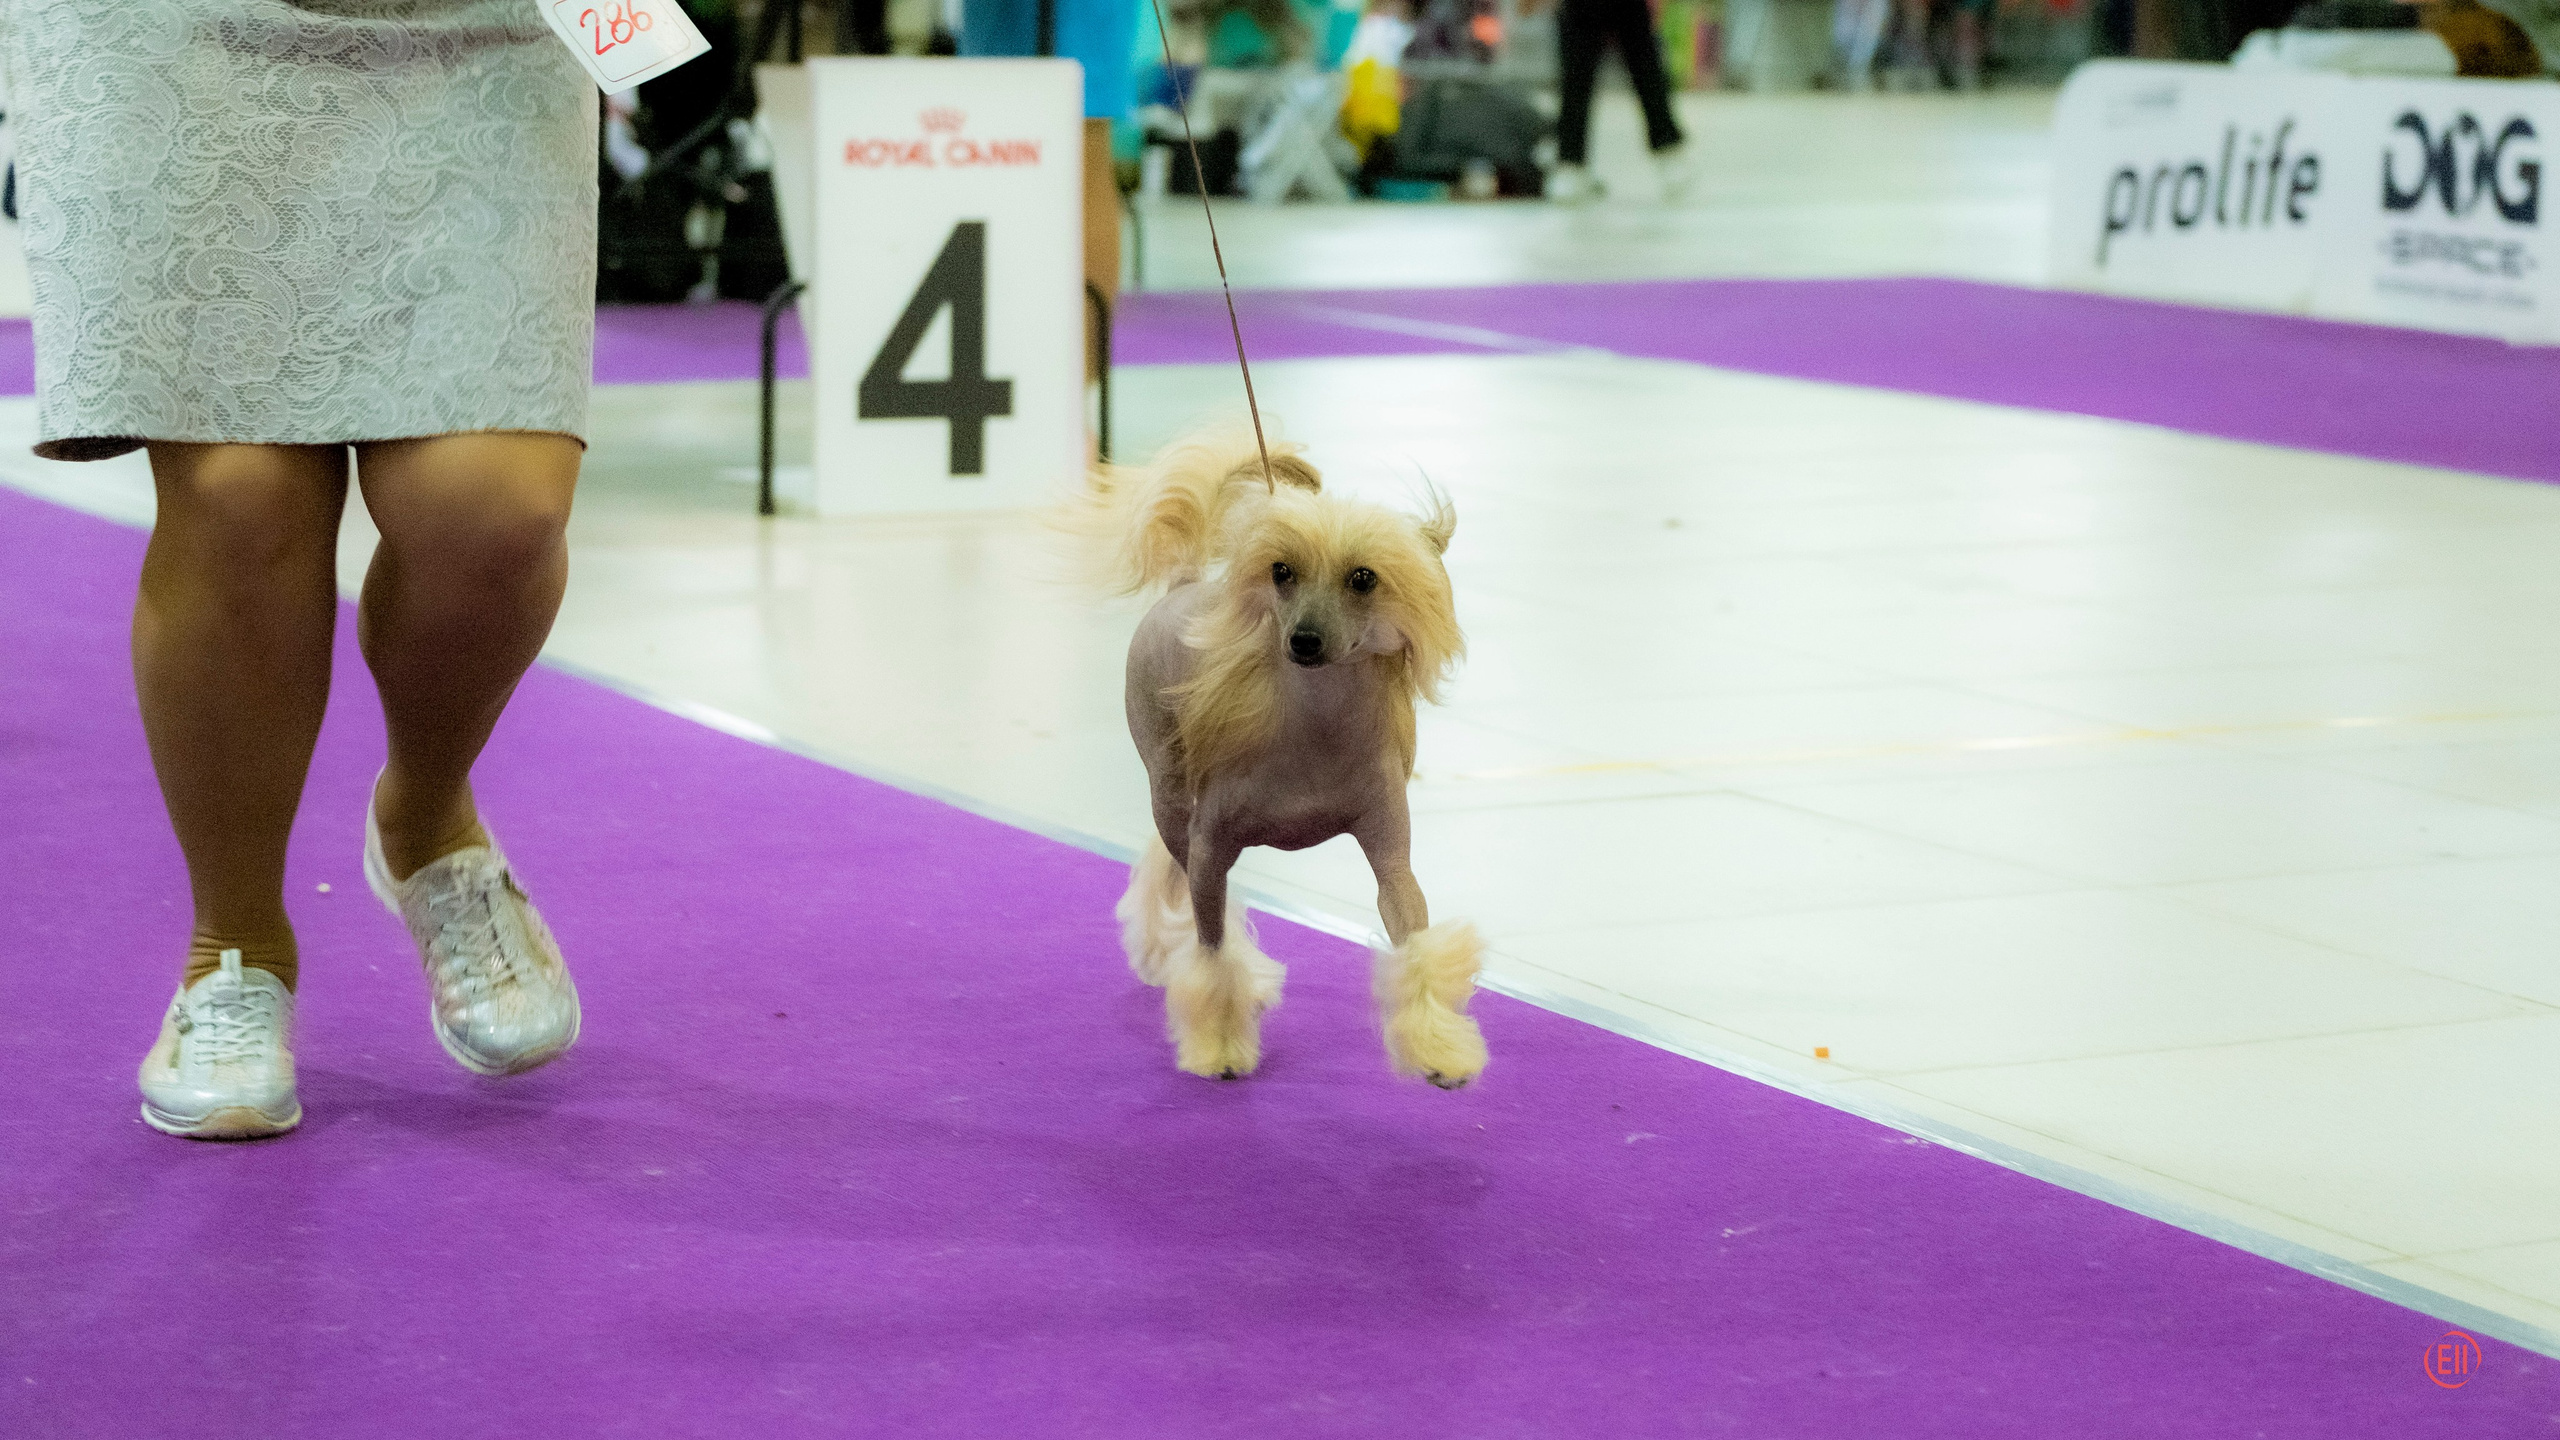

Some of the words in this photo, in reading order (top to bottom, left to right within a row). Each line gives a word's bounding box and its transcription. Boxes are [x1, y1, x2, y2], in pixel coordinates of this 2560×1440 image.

[579, 0, 653, 56] 286
[843, 138, 937, 168] ROYAL
[945, 138, 1042, 167] CANIN
[2096, 115, 2322, 270] prolife
[2381, 110, 2541, 225] DOG
[857, 220, 1014, 477] 4
